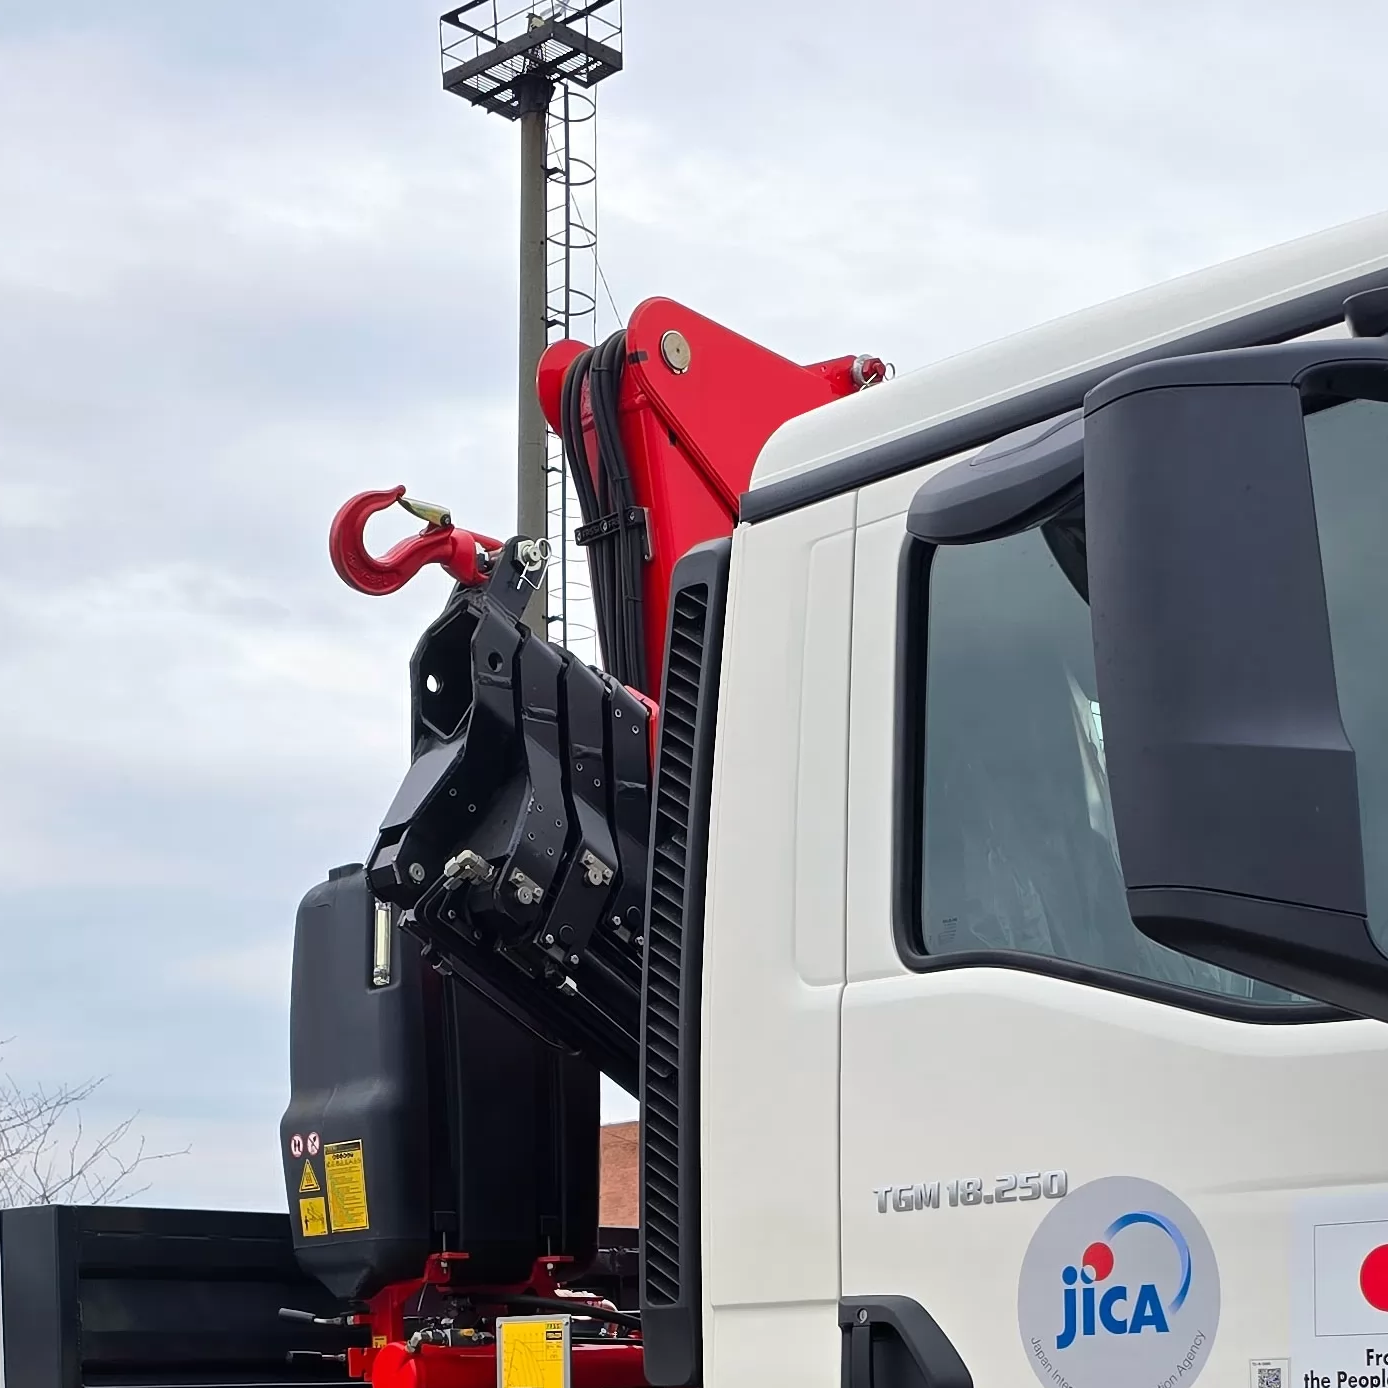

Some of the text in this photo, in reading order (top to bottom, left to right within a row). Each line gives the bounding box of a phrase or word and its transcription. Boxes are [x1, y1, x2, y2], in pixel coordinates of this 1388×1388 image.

[873, 1169, 1067, 1213] TGM 18.250
[1031, 1336, 1053, 1374] Japan
[1177, 1329, 1207, 1377] Agency
